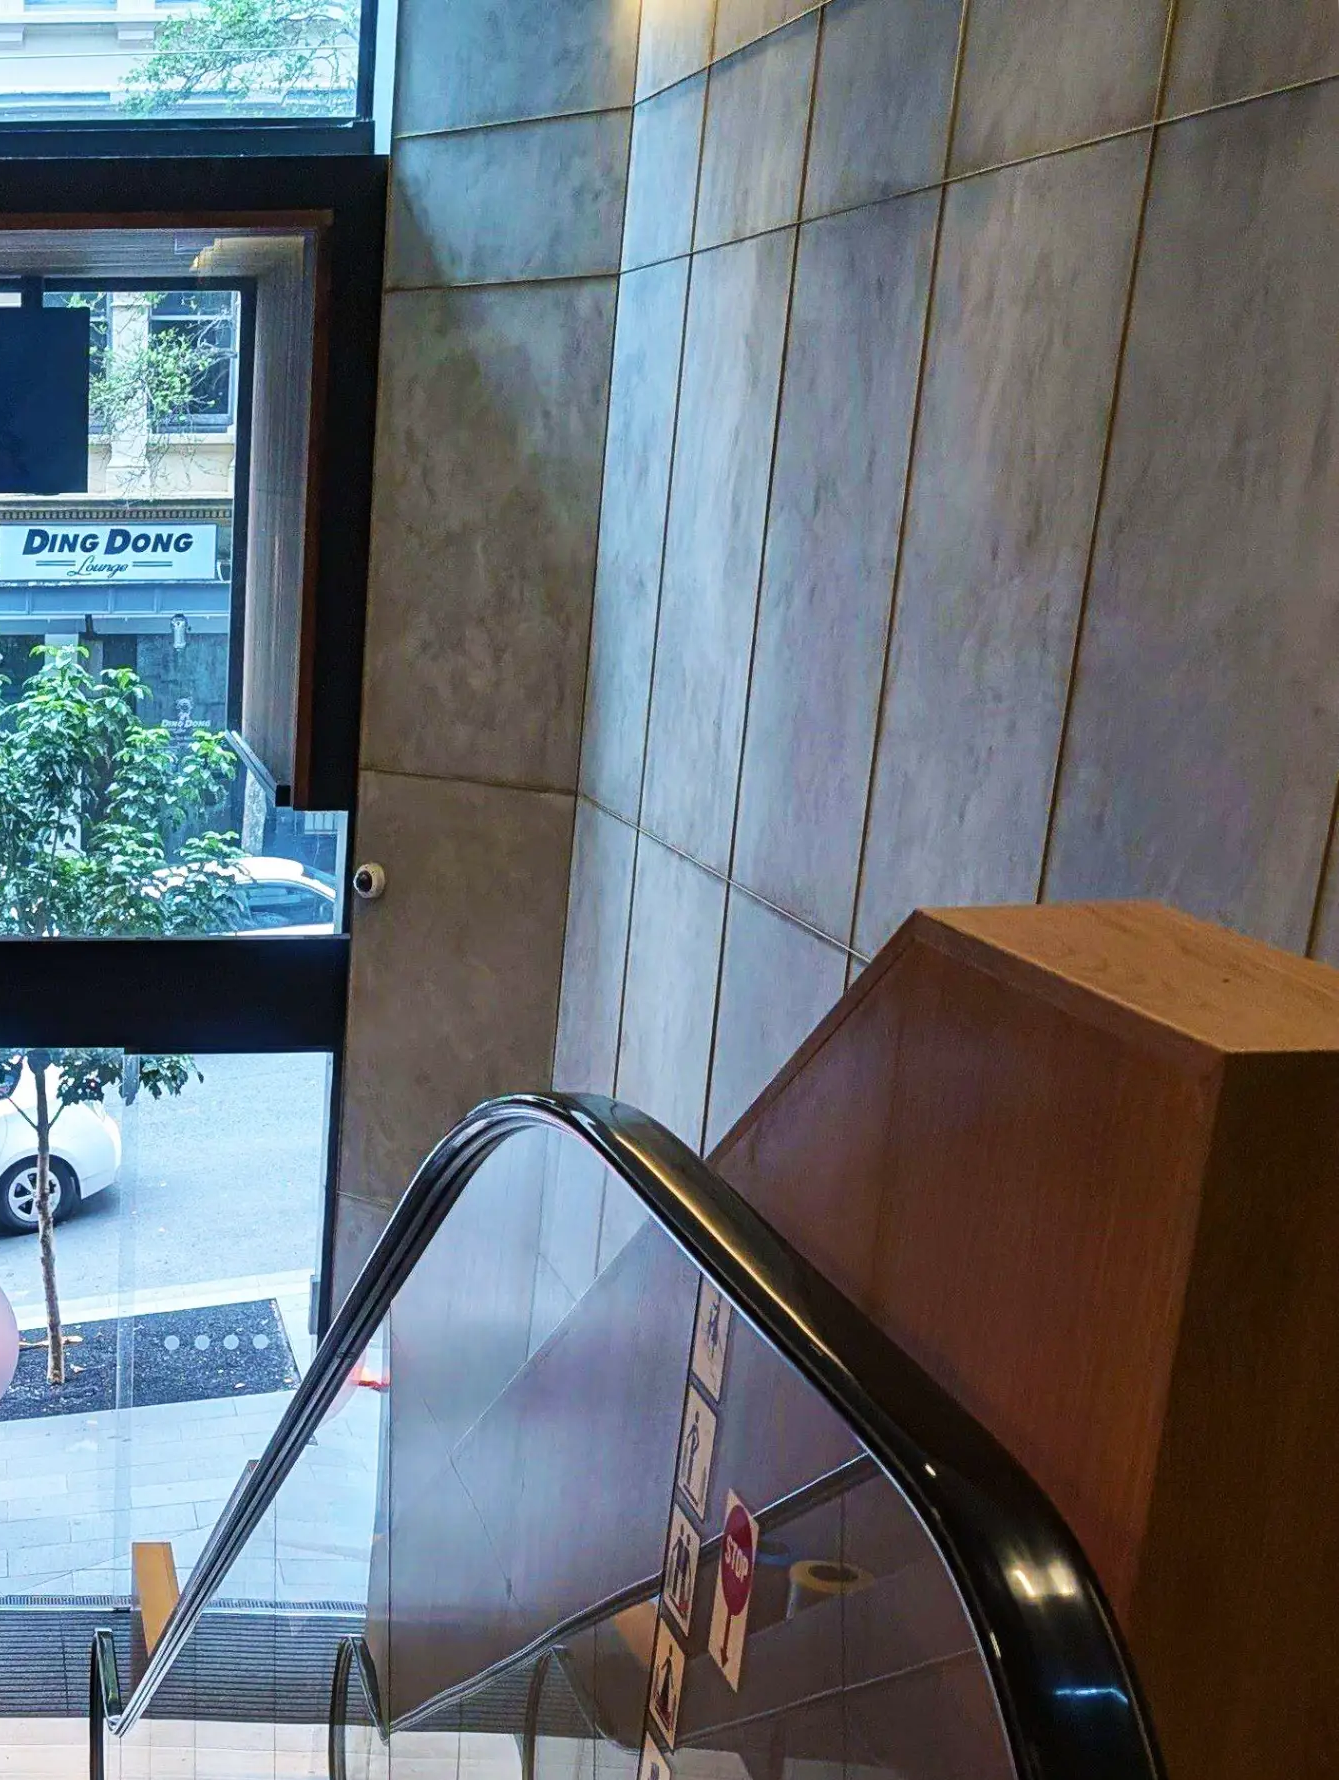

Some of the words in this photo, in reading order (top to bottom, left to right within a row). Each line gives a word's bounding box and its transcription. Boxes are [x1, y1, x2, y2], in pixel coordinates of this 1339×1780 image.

[22, 529, 99, 555] DING
[104, 529, 194, 555] DONG
[67, 555, 128, 577] Lounge
[725, 1534, 749, 1583] STOP
